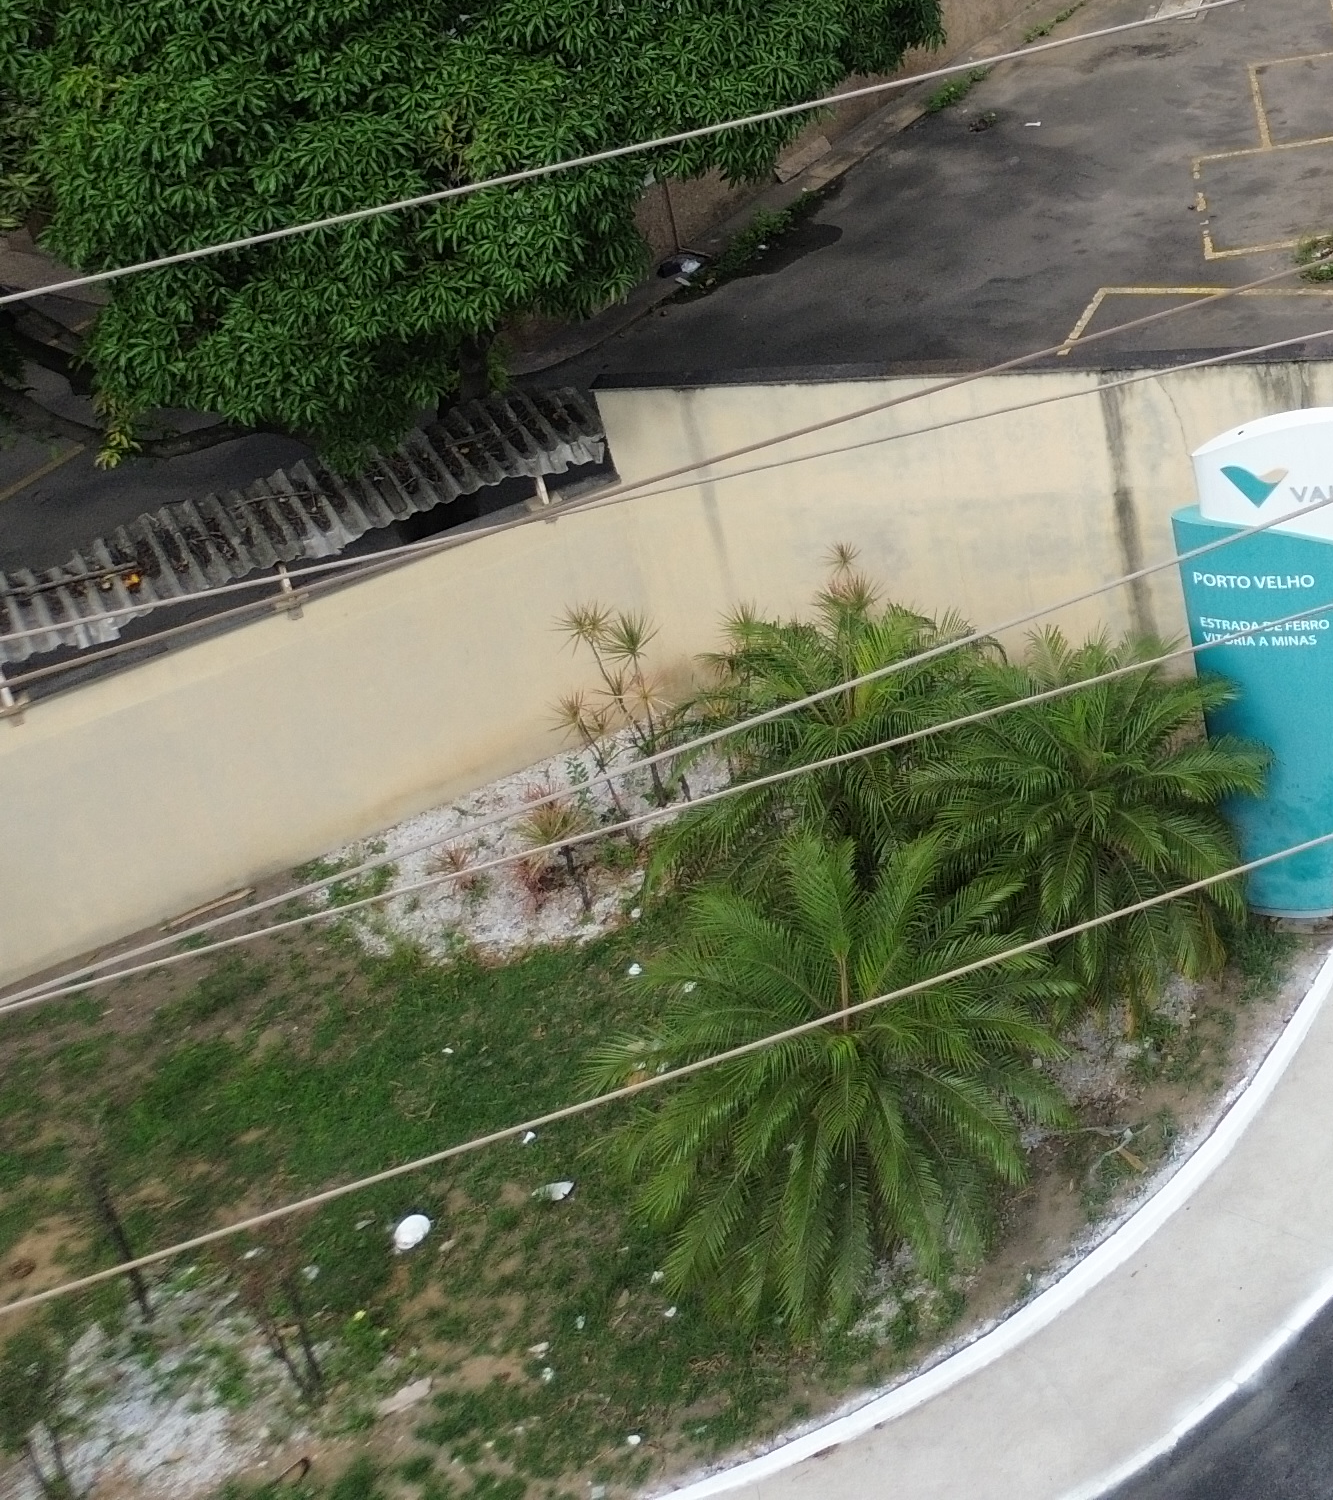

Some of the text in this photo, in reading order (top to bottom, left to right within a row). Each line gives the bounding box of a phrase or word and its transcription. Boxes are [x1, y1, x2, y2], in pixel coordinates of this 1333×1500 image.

[1193, 571, 1315, 589] PORTO VELHO
[1199, 616, 1260, 632] ESTRADA
[1285, 619, 1330, 631] FERRO
[1259, 636, 1269, 647] A
[1271, 634, 1318, 647] MINAS
